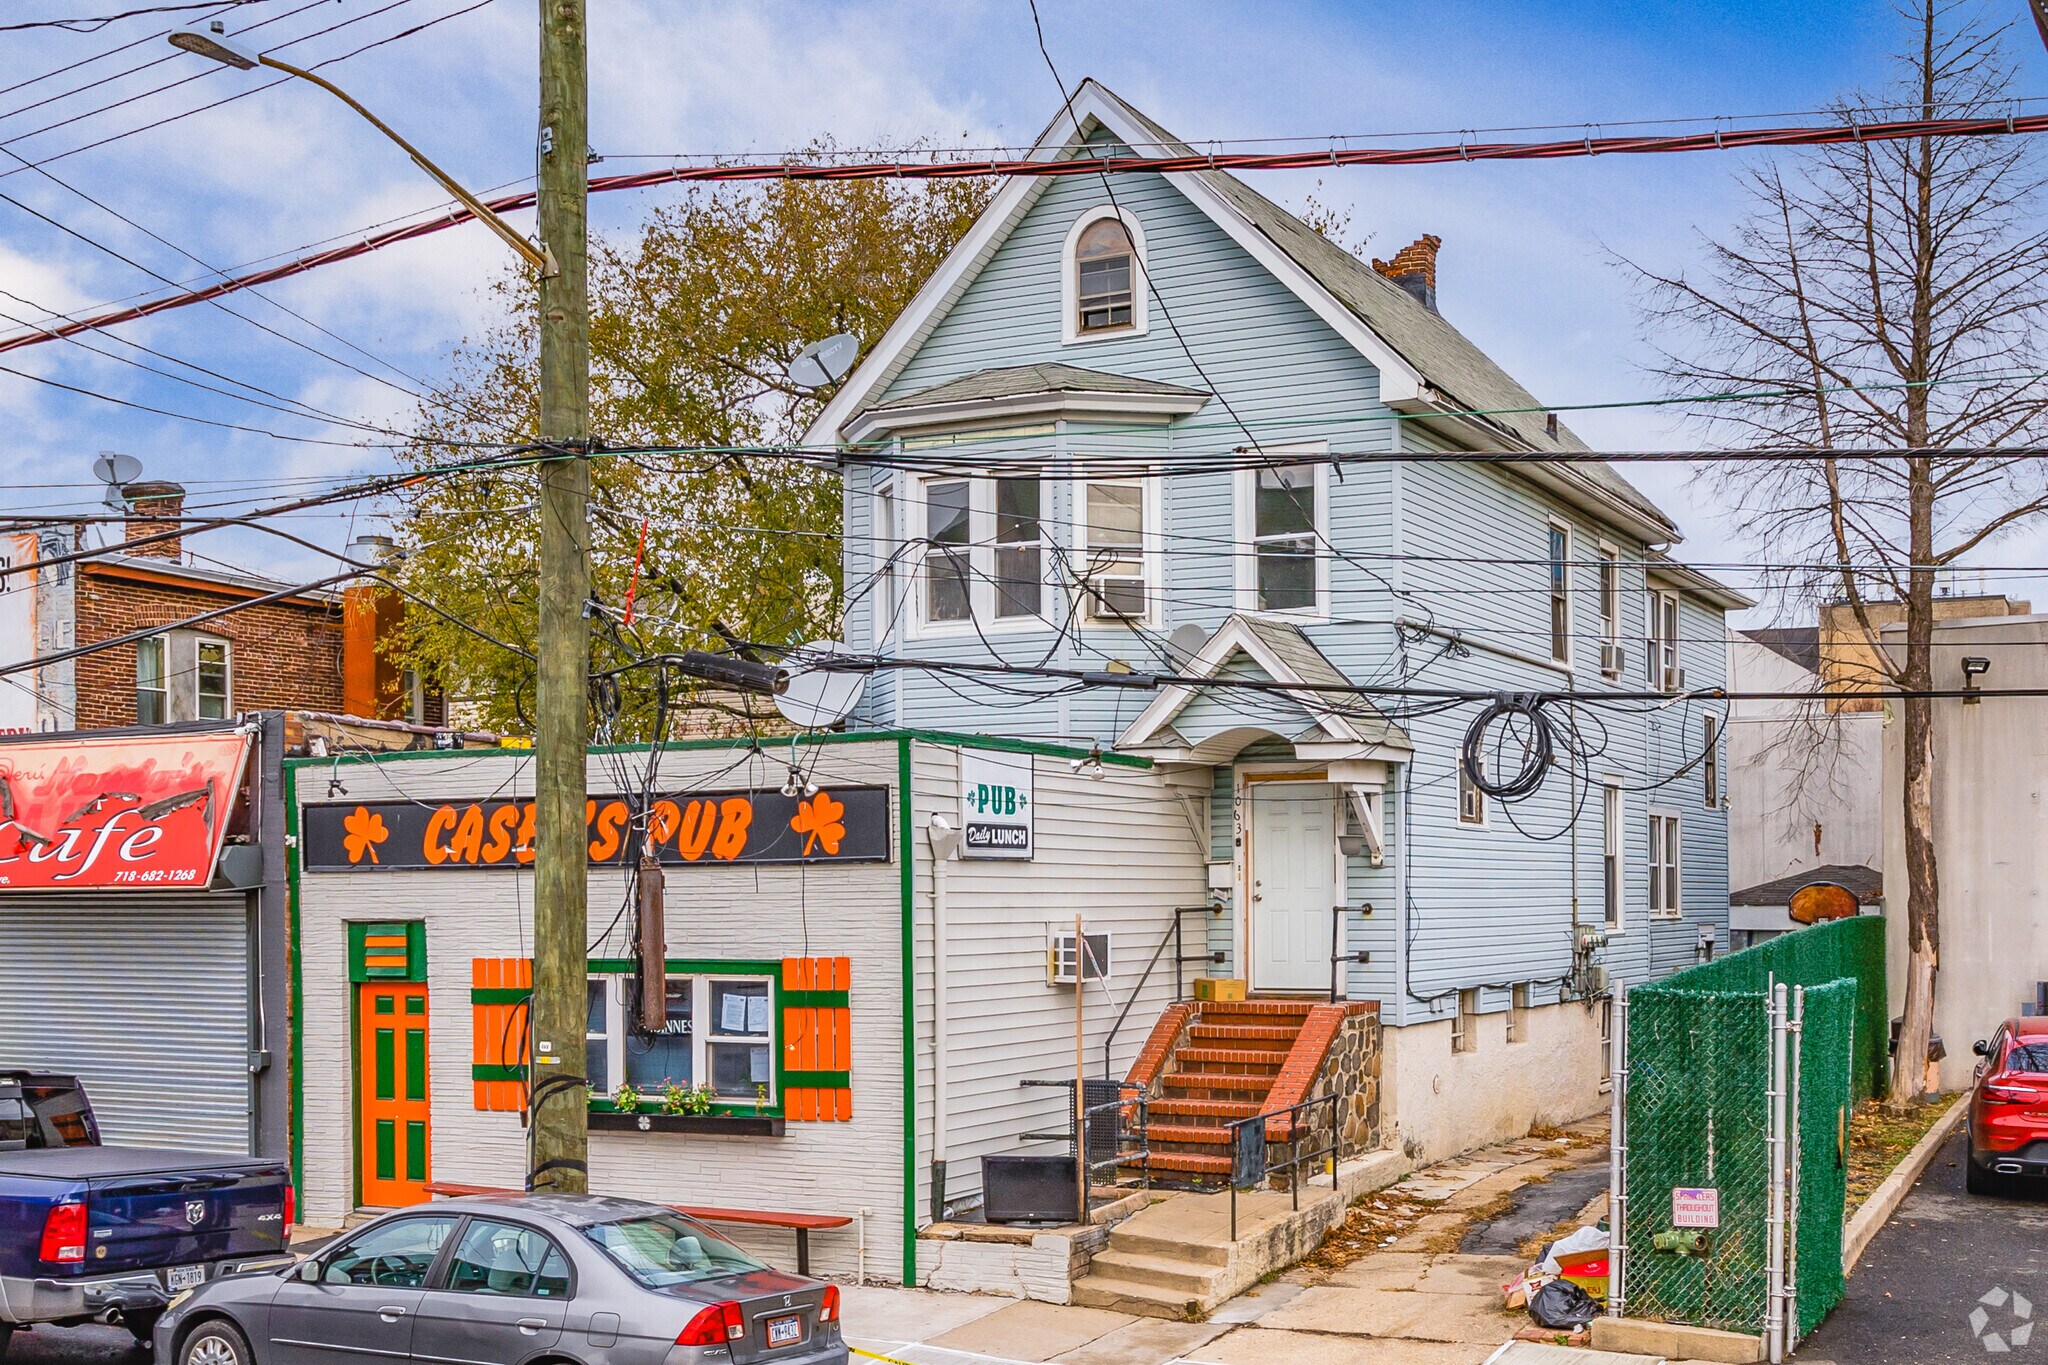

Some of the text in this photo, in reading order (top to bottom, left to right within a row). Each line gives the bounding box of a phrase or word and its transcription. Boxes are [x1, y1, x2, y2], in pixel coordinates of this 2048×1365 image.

[977, 784, 1016, 815] PUB
[647, 797, 752, 861] PUB
[967, 826, 1027, 845] Daily LUNCH
[113, 869, 197, 882] 718-682-1268
[1676, 1203, 1715, 1212] THROUGHOUT
[1677, 1214, 1714, 1223] BUILDING
